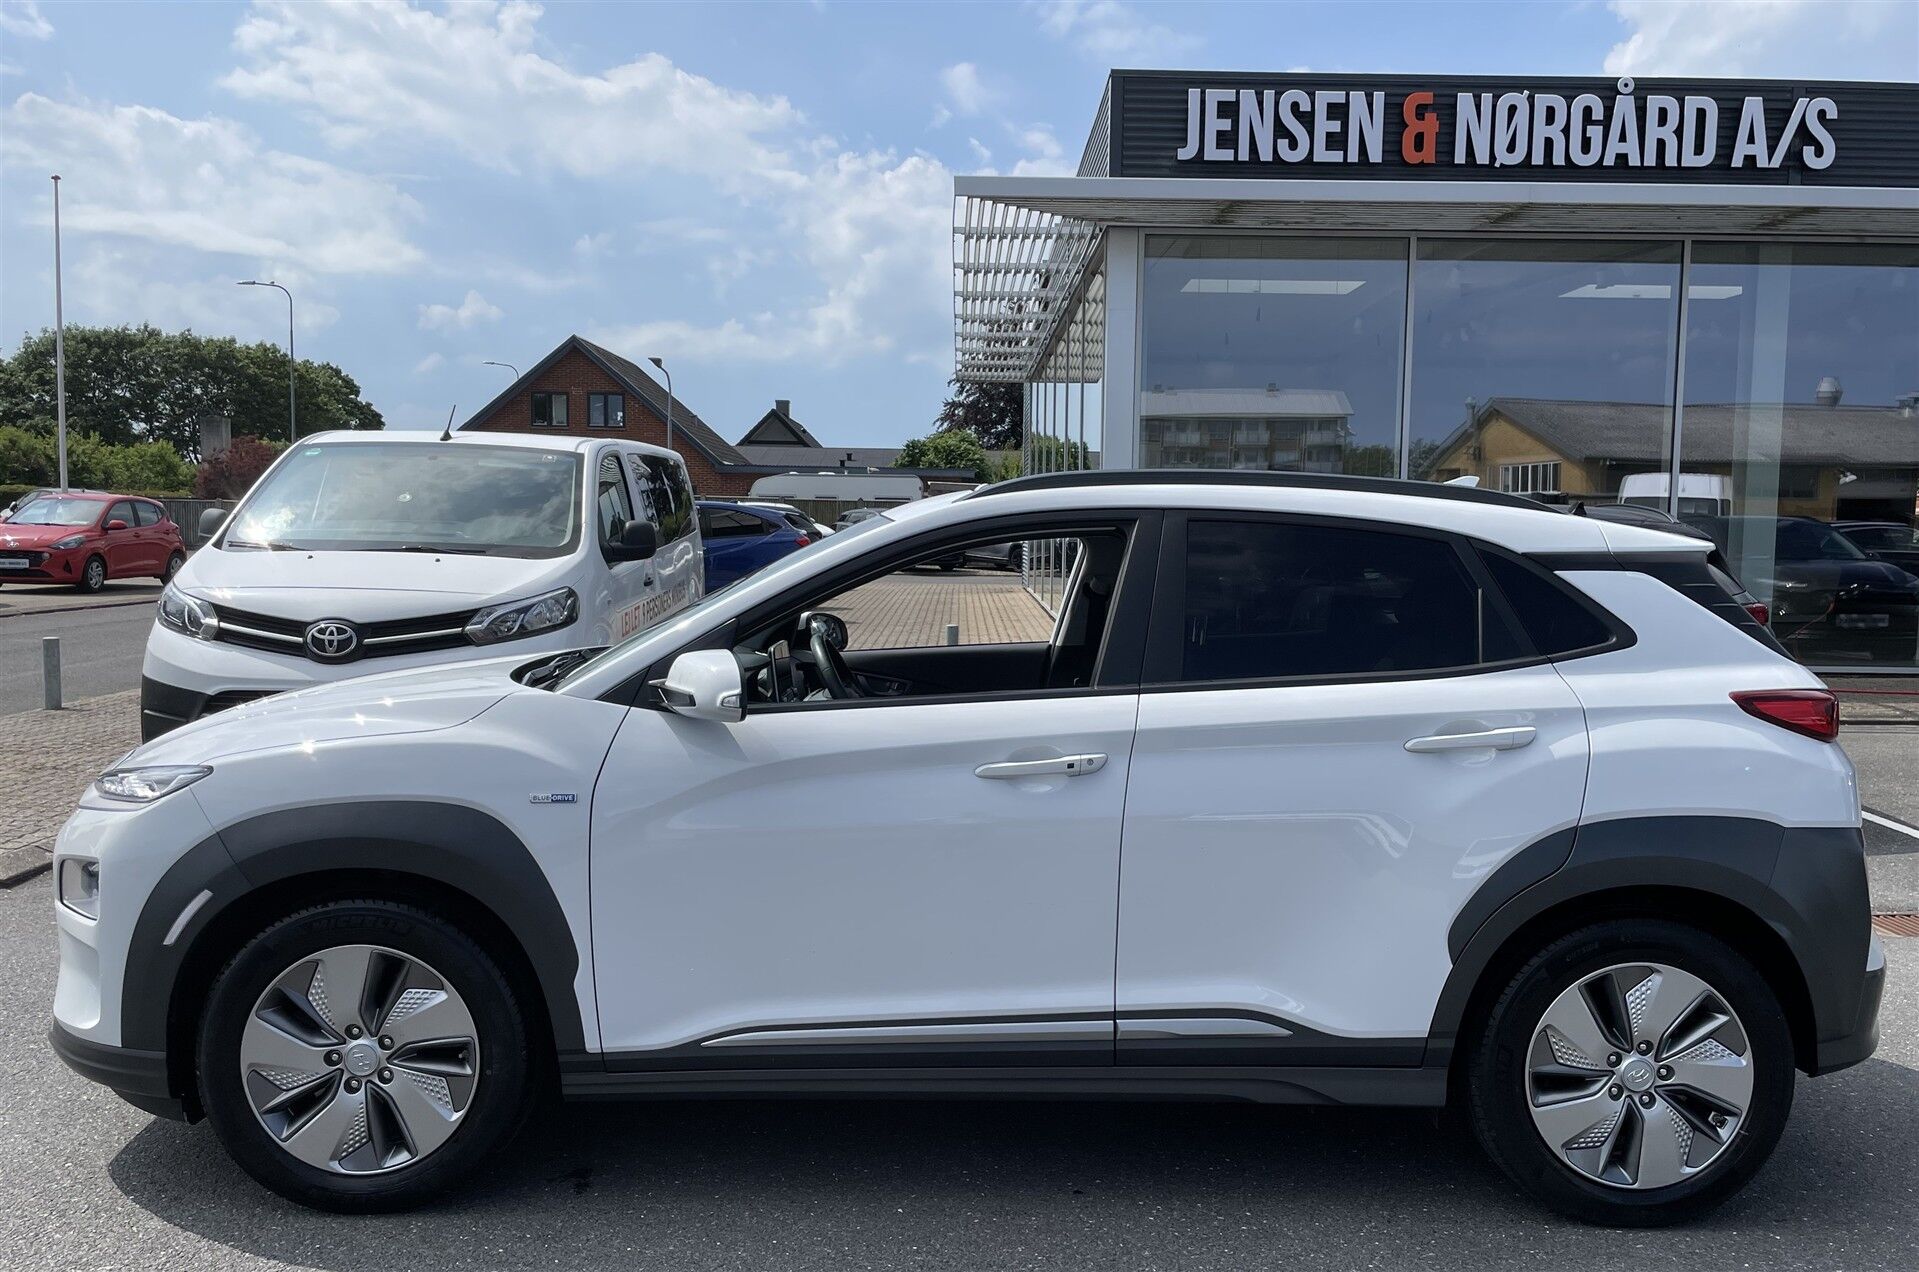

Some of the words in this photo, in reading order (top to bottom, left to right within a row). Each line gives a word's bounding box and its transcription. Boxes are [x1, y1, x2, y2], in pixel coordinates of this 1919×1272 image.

[1177, 88, 1385, 164] JENSEN
[1401, 91, 1440, 164] &
[1454, 77, 1719, 168] NØRGÅRD
[1730, 97, 1838, 169] A/S
